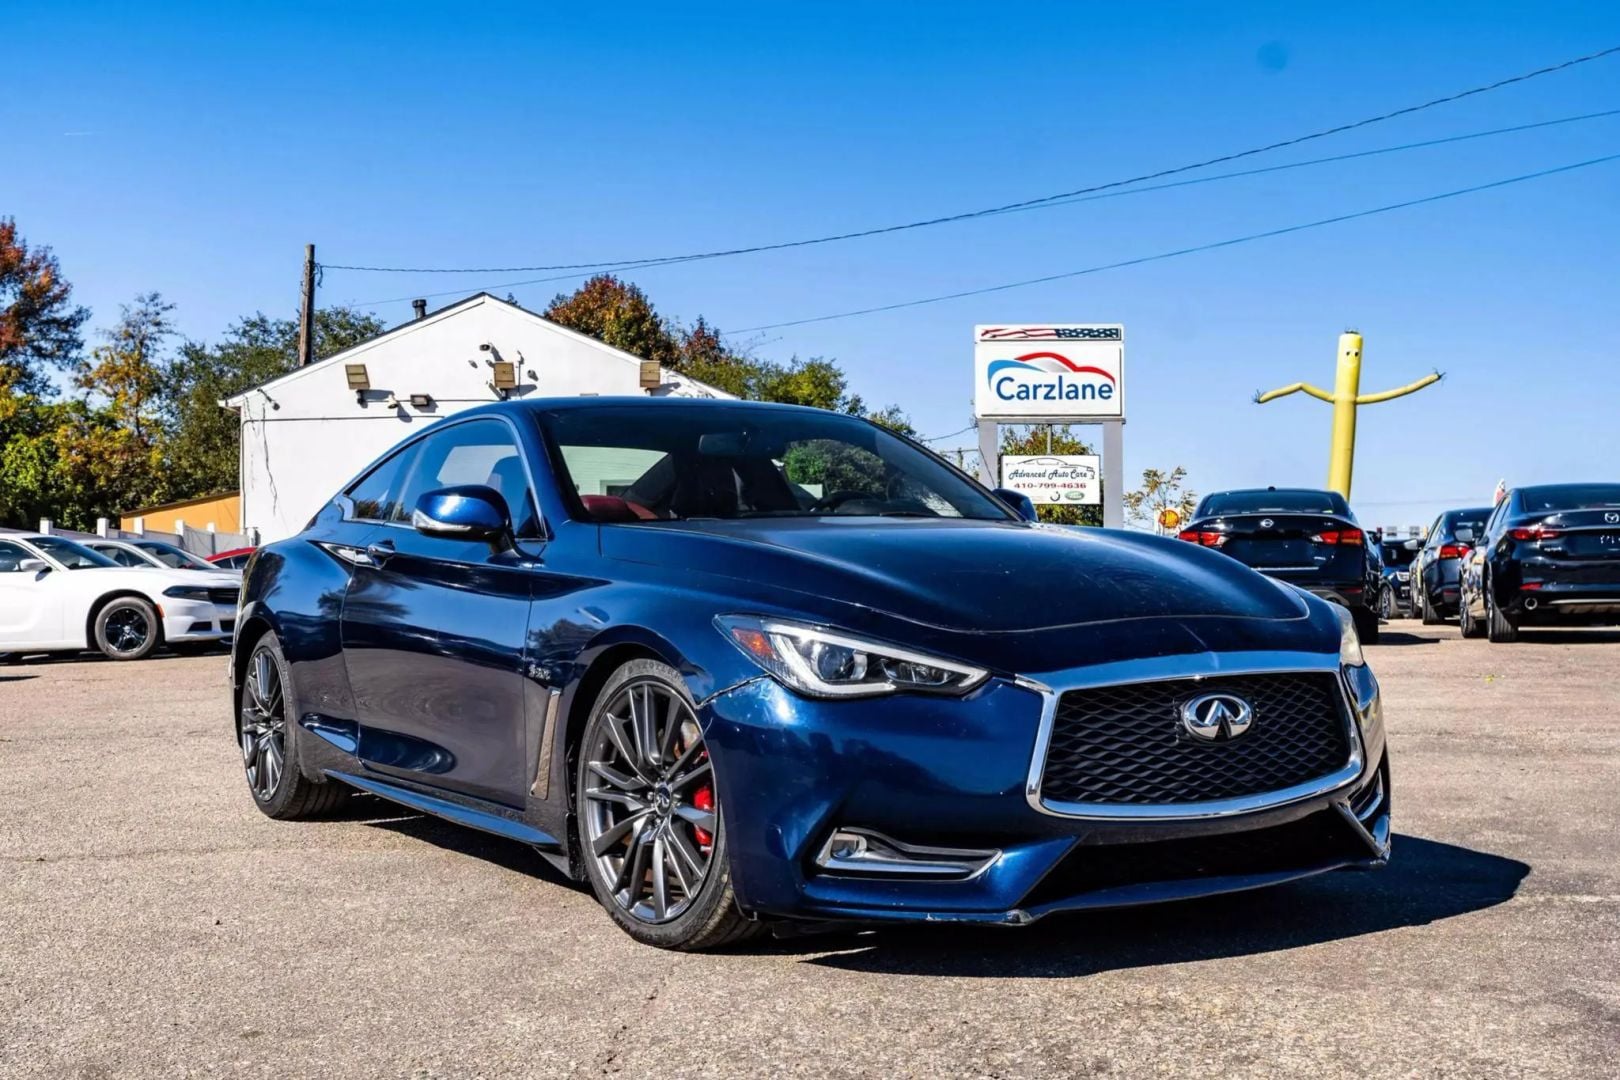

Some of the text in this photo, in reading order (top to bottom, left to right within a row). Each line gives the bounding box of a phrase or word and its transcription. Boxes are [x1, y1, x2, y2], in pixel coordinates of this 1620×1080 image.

[996, 375, 1113, 400] Carzlane
[1008, 468, 1087, 480] Advanced Auto Care
